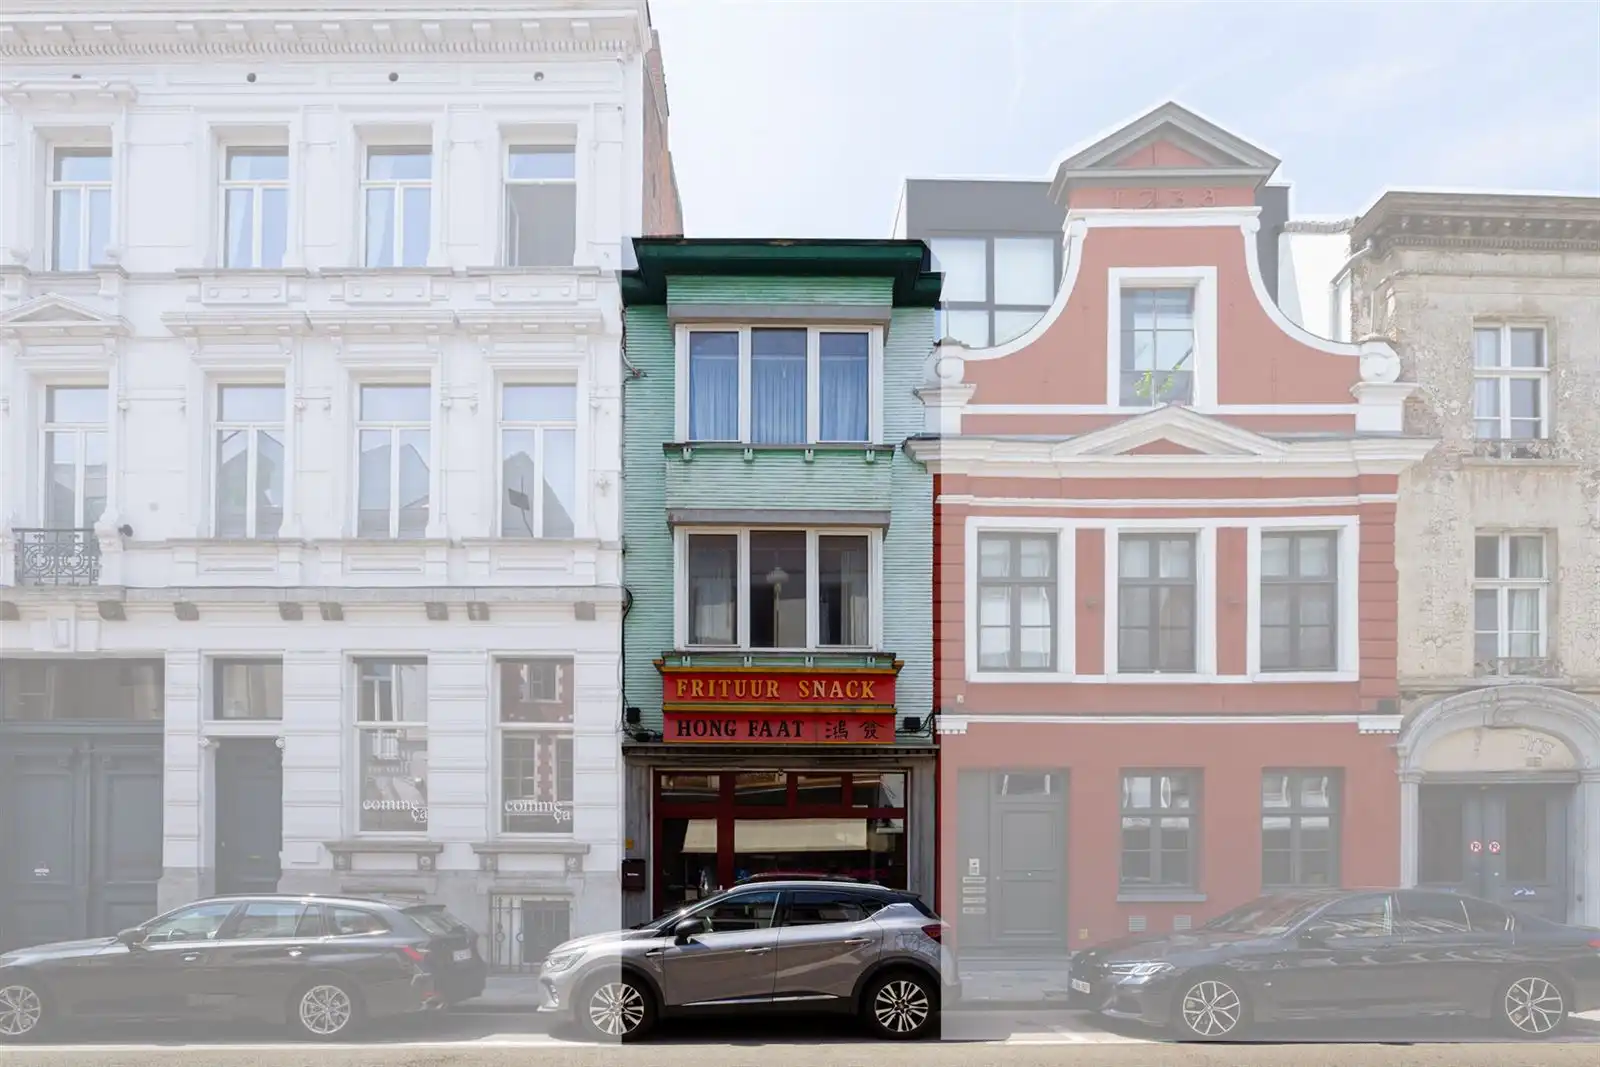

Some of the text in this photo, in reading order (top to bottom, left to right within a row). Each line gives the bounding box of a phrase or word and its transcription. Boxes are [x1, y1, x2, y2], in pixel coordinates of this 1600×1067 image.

[676, 679, 876, 698] FRITUUR SNACK
[676, 719, 805, 738] HONG FAAT
[363, 799, 419, 810] comme
[505, 799, 562, 812] comme
[553, 810, 571, 824] ça
